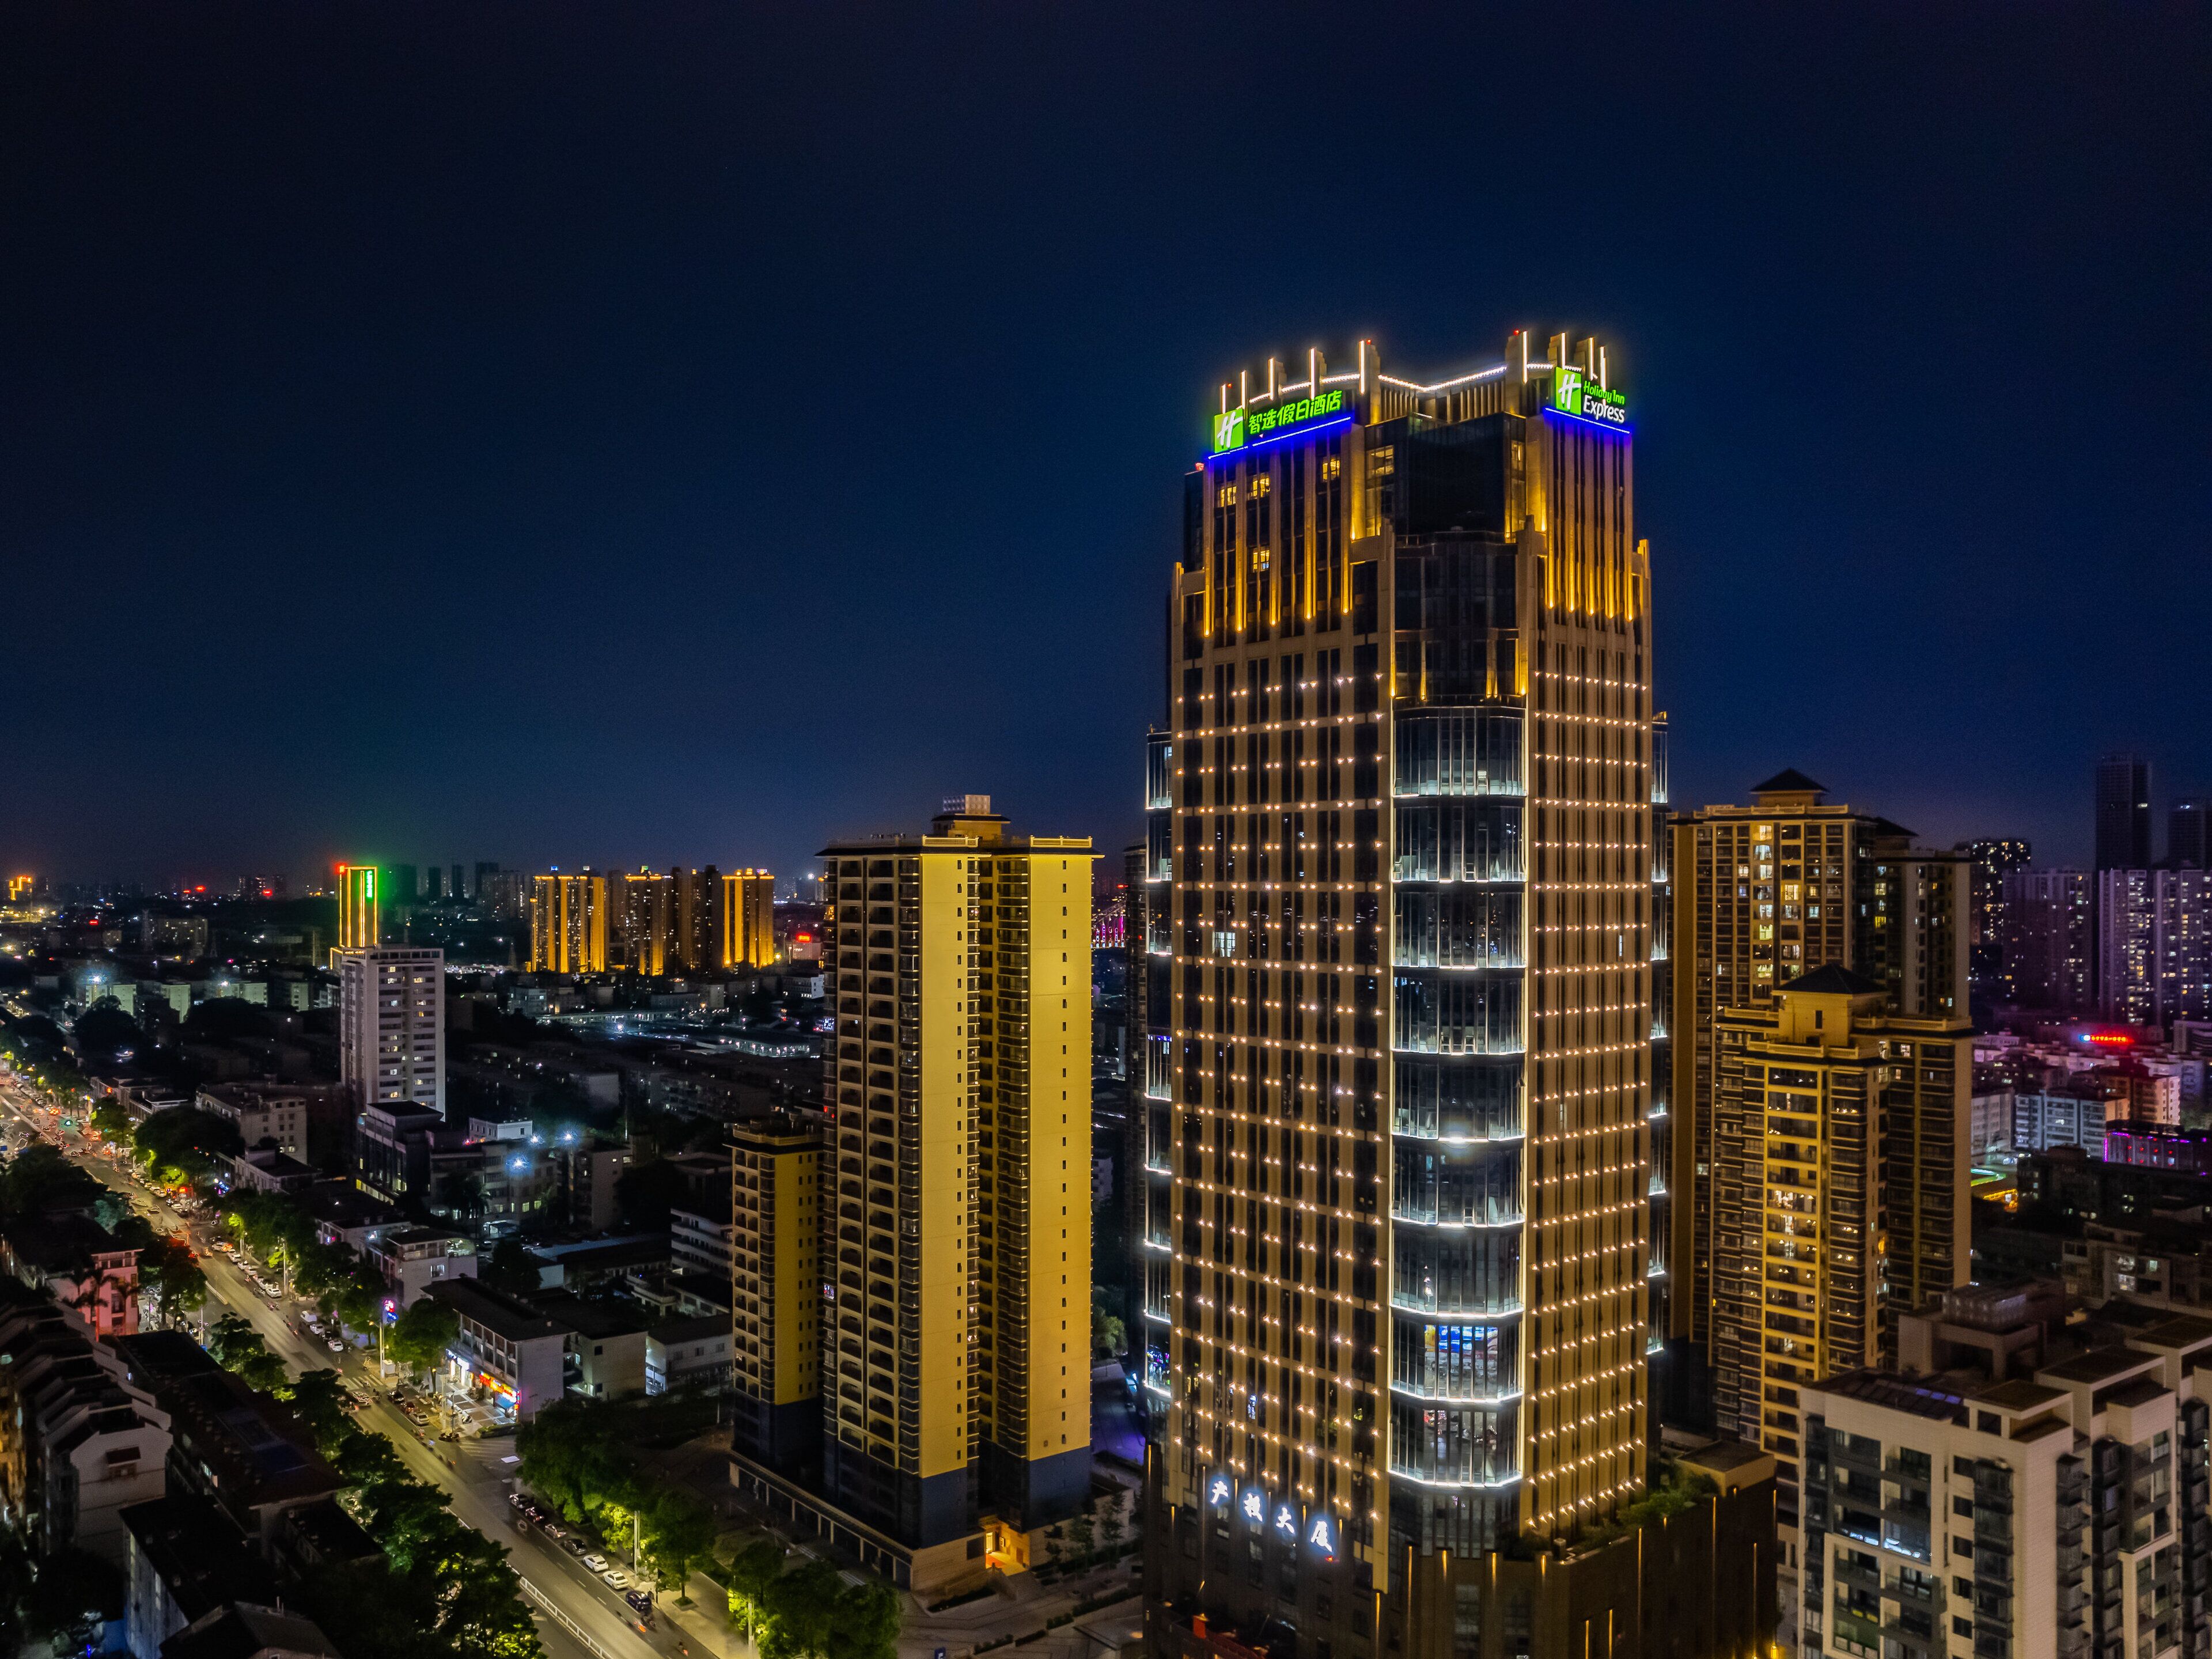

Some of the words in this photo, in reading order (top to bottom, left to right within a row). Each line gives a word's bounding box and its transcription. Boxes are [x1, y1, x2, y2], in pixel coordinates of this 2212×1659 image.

[1584, 380, 1612, 403] Holiday
[1612, 389, 1625, 404] Inn
[1248, 390, 1342, 434] 智选假日酒店
[1584, 394, 1625, 423] Express
